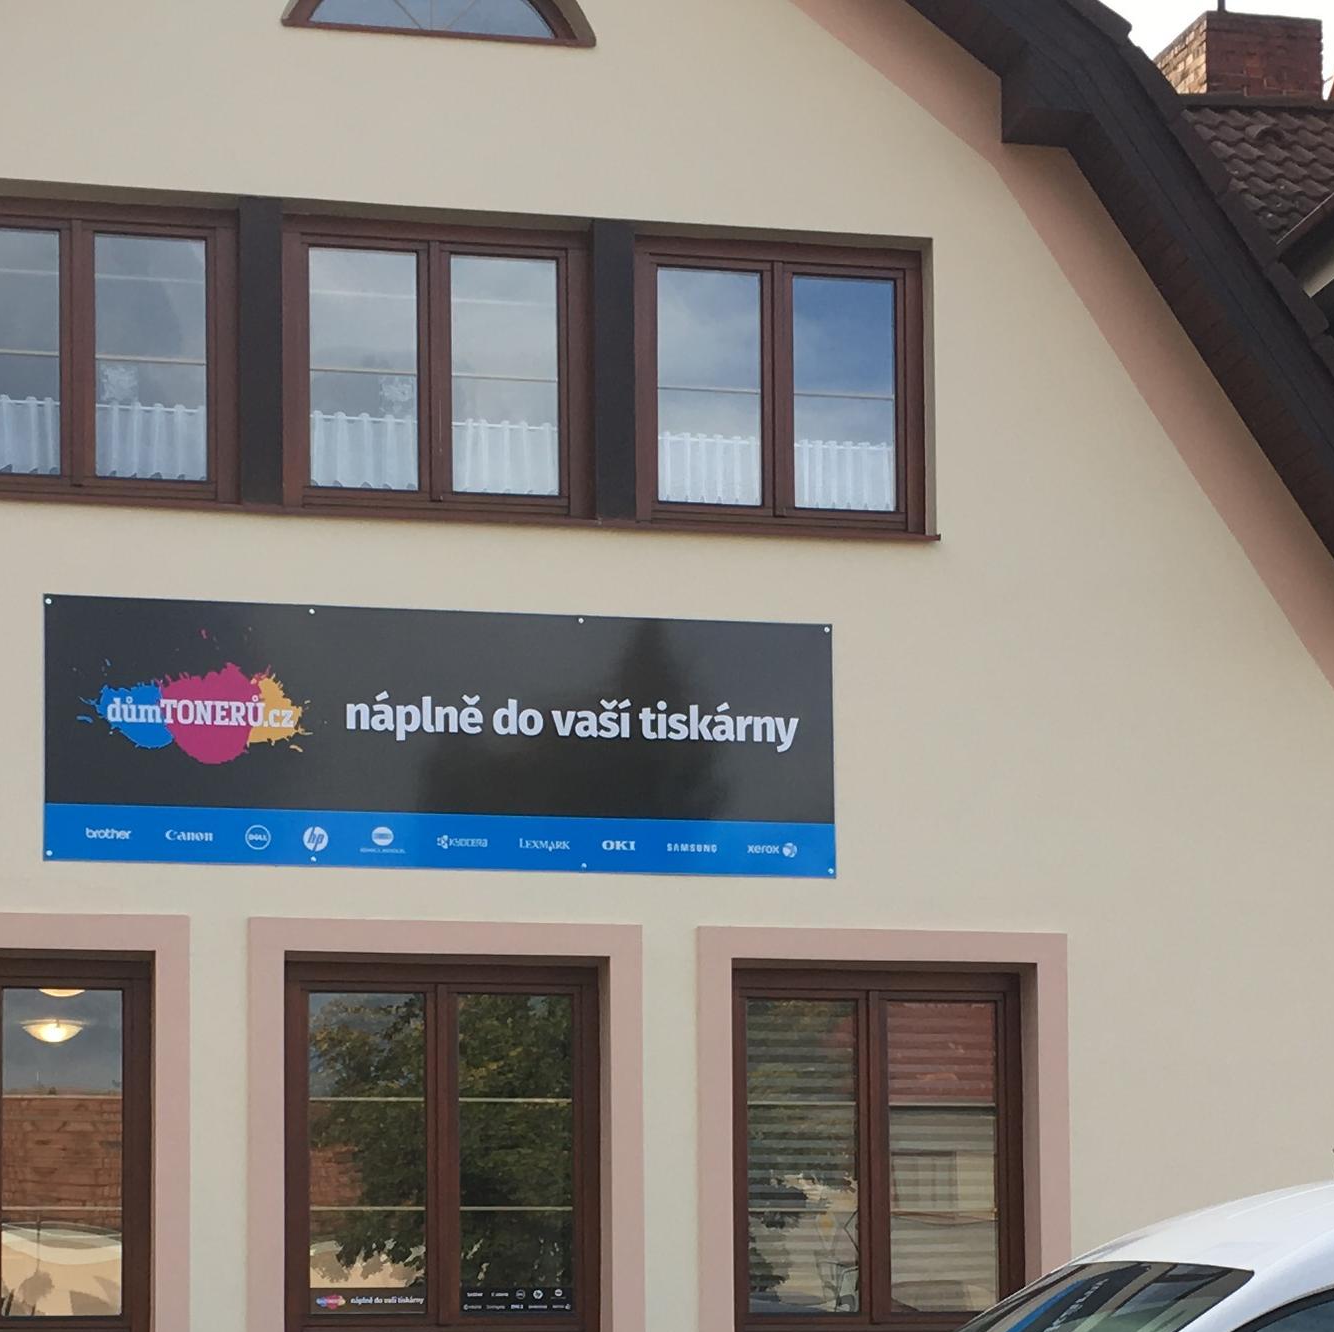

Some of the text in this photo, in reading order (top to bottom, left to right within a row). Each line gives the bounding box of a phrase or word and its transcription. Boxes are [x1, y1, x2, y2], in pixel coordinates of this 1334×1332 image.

[107, 695, 296, 729] důmTONERŮ.cz
[345, 690, 800, 753] náplně do vaší tiskárny
[85, 826, 132, 840] brother
[165, 829, 214, 842] Canon
[449, 837, 489, 848] KYOCERA
[601, 839, 636, 851] OKI
[667, 843, 718, 854] SAMSUNG
[747, 844, 780, 855] xerox
